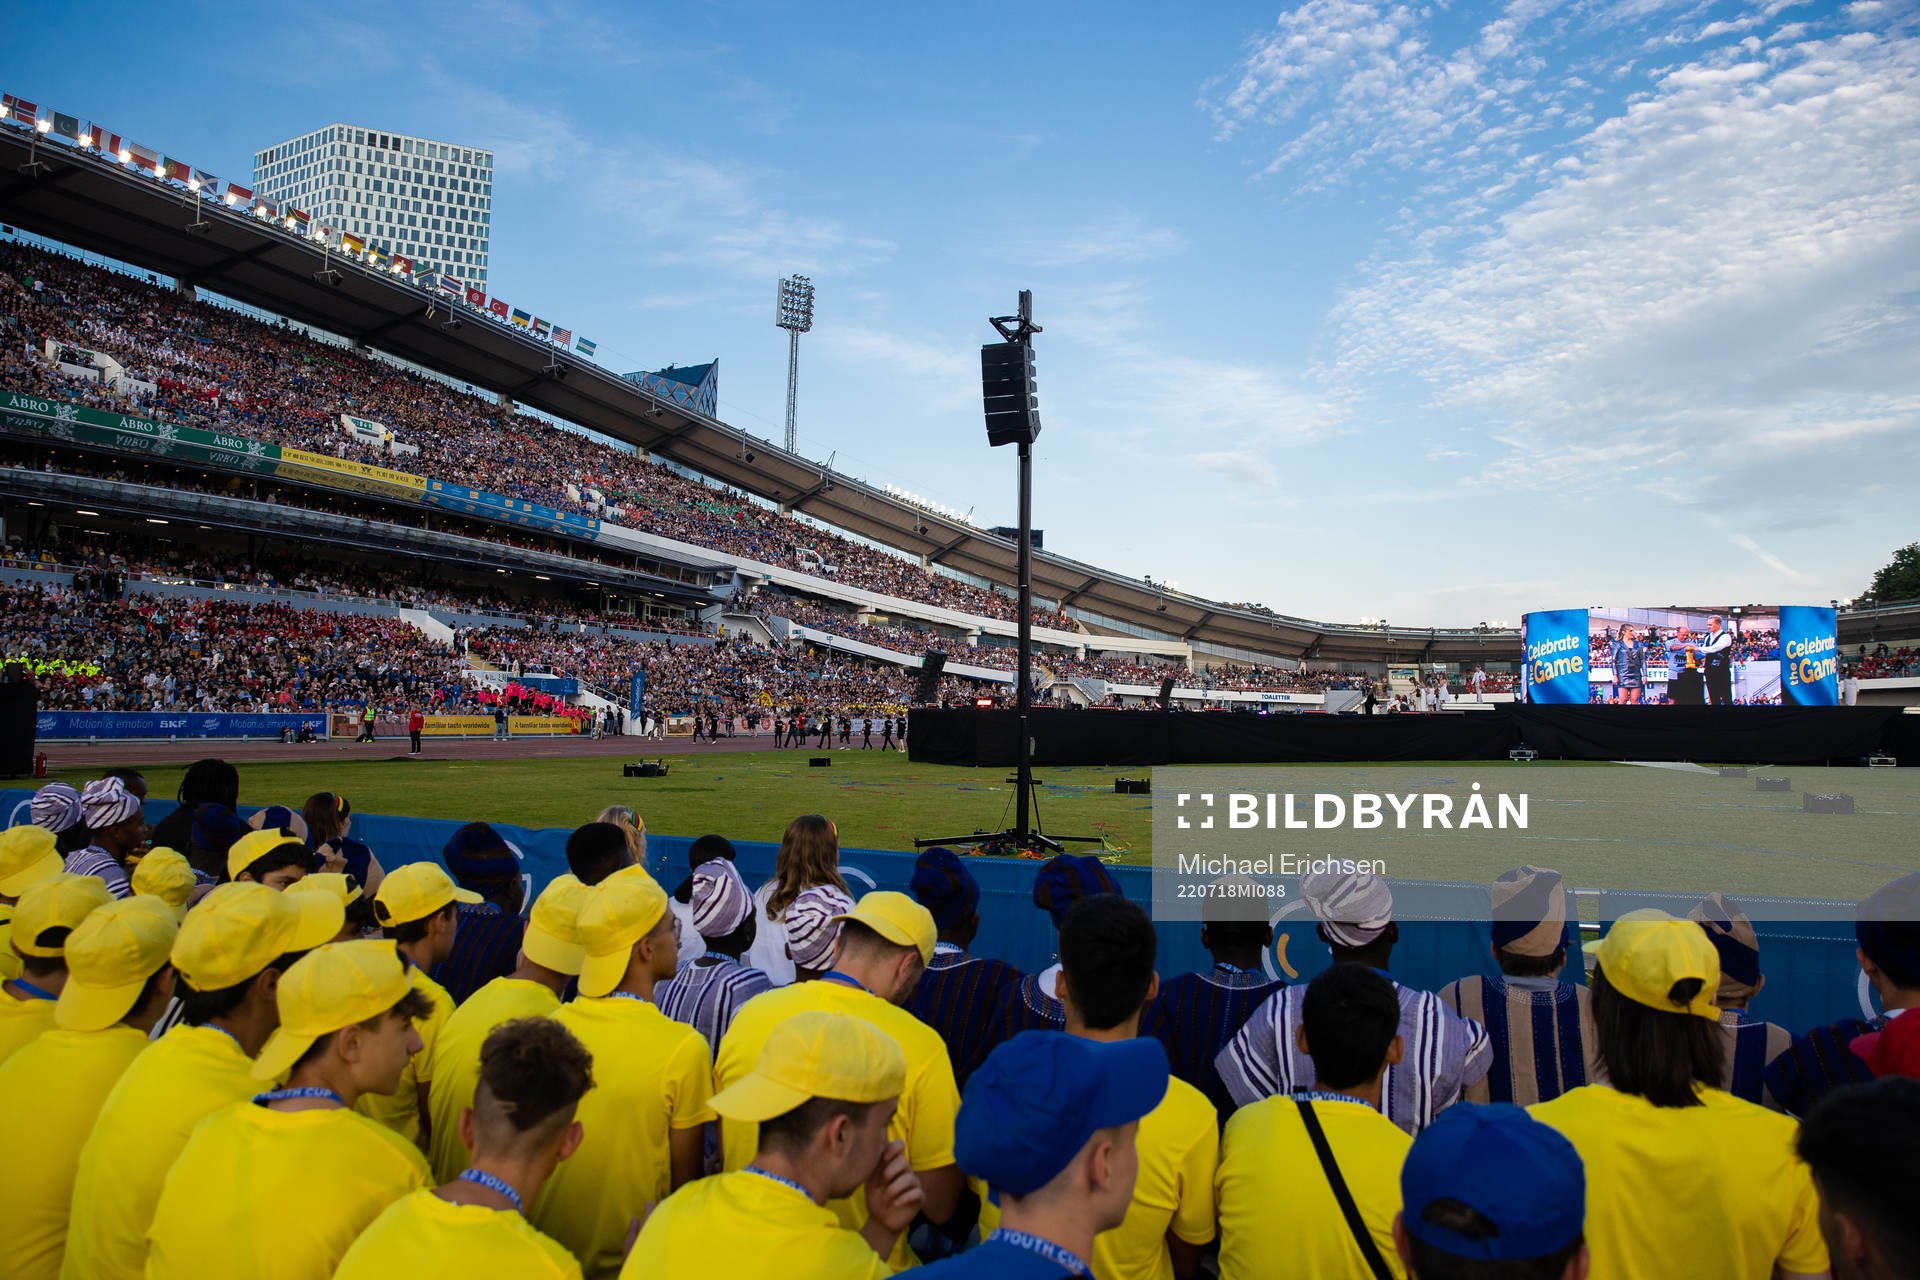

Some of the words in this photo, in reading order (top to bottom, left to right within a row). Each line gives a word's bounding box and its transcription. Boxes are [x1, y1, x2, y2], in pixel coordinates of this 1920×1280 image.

[9, 395, 49, 412] ÅBRO
[119, 417, 153, 432] ÅBRO
[213, 435, 243, 449] ÅBRO
[1527, 634, 1580, 662] Celebrate
[1786, 634, 1835, 659] Celebrate
[1534, 655, 1583, 684] Game
[1799, 656, 1837, 684] Game
[69, 718, 102, 728] Motion
[105, 719, 113, 728] is
[116, 719, 154, 728] emotion
[160, 720, 187, 728] SKF
[1003, 1230, 1056, 1260] YOUTH
